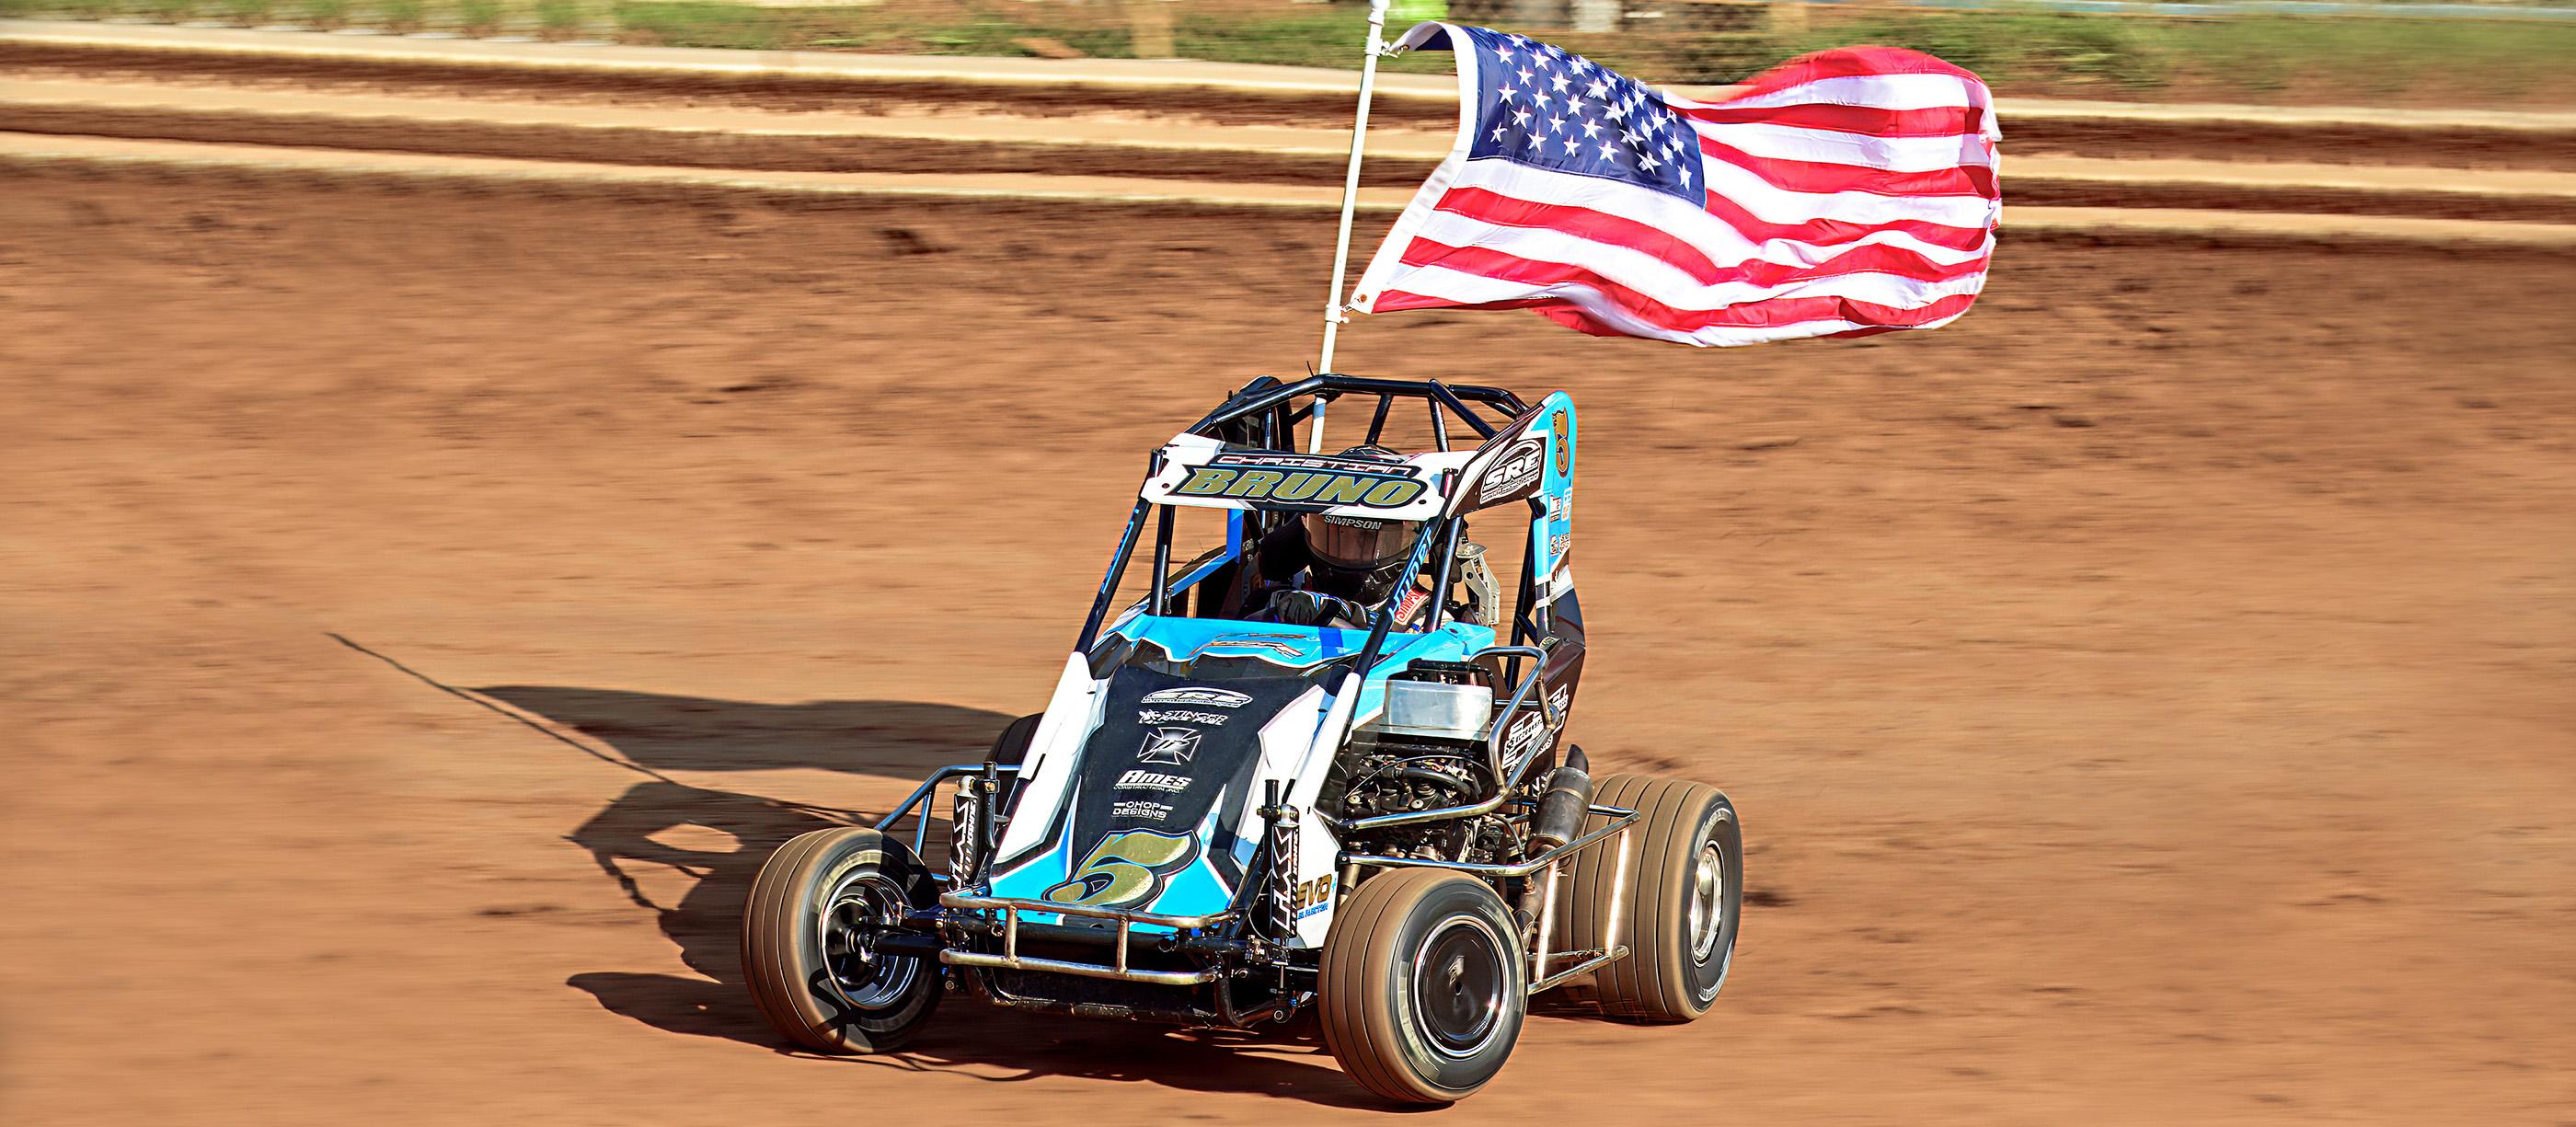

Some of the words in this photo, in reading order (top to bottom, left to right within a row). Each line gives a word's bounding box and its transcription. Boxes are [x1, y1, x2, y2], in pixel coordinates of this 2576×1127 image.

[1217, 455, 1410, 476] CHRISTIAN
[1484, 447, 1541, 489] SRE
[1177, 466, 1420, 506] BRUNO
[1324, 514, 1382, 530] SIMPSON
[1112, 808, 1167, 819] DESIGNS
[1044, 828, 1200, 908] 5
[1296, 874, 1332, 910] EVO
